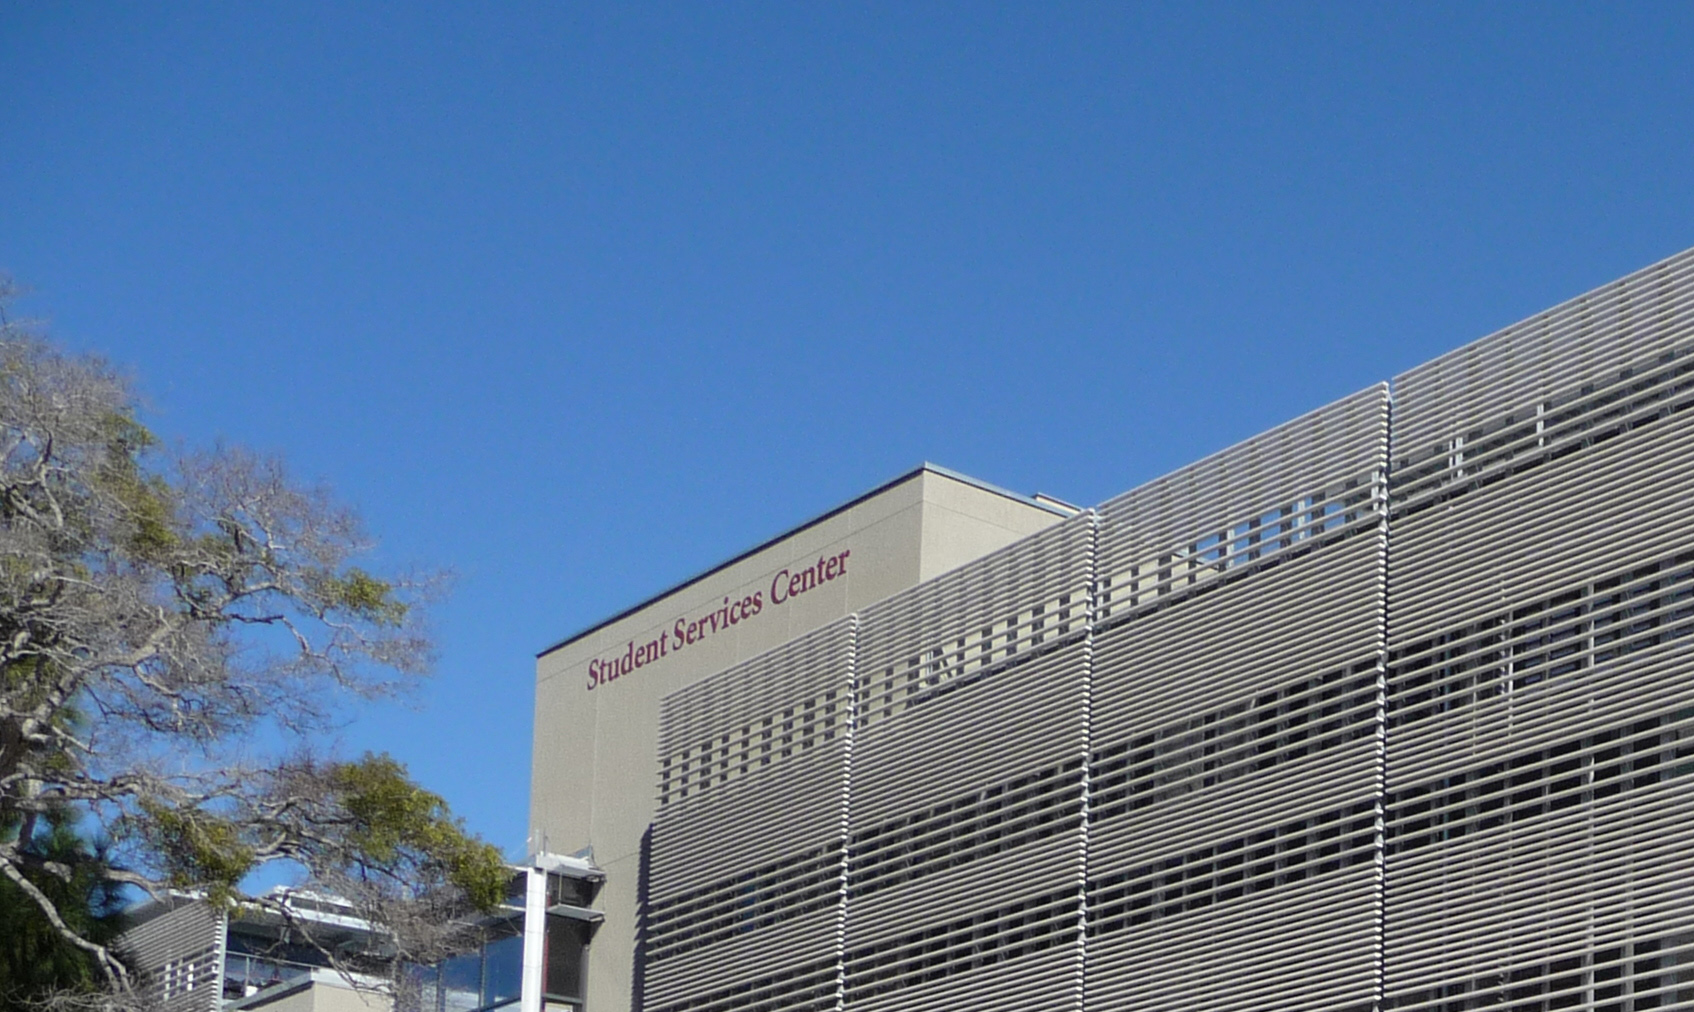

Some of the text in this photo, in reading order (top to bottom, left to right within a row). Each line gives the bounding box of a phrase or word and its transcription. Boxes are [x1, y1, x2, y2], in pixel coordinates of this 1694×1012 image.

[587, 550, 851, 691] Student Services Center
